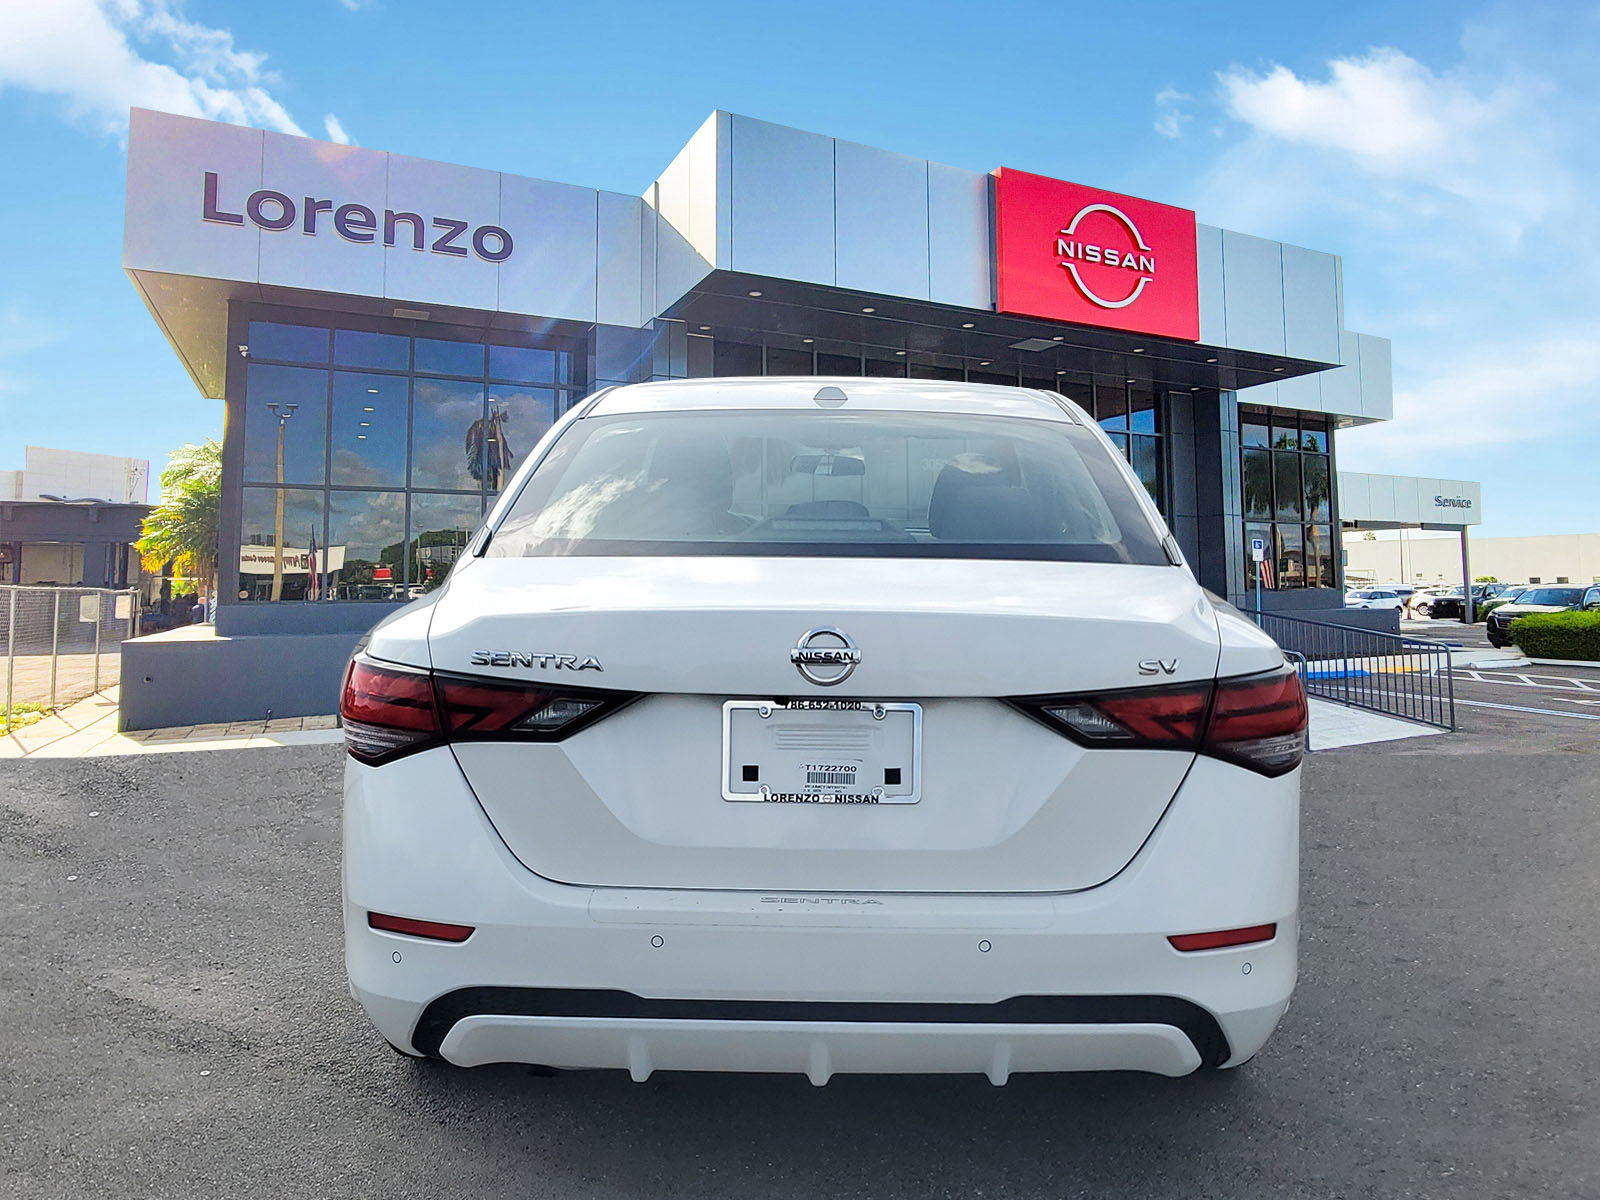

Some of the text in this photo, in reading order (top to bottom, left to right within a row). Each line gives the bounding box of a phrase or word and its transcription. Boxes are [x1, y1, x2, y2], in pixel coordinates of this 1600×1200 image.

[202, 171, 514, 262] Lorenzo
[1057, 238, 1155, 274] NISSAN
[1434, 495, 1472, 509] Service
[471, 649, 604, 672] SENTRA
[797, 651, 855, 662] NISSAN
[1138, 658, 1180, 675] SV
[805, 764, 857, 773] T1722700
[764, 793, 879, 804] LORENZO NISSAN
[760, 896, 884, 905] SENTRA
